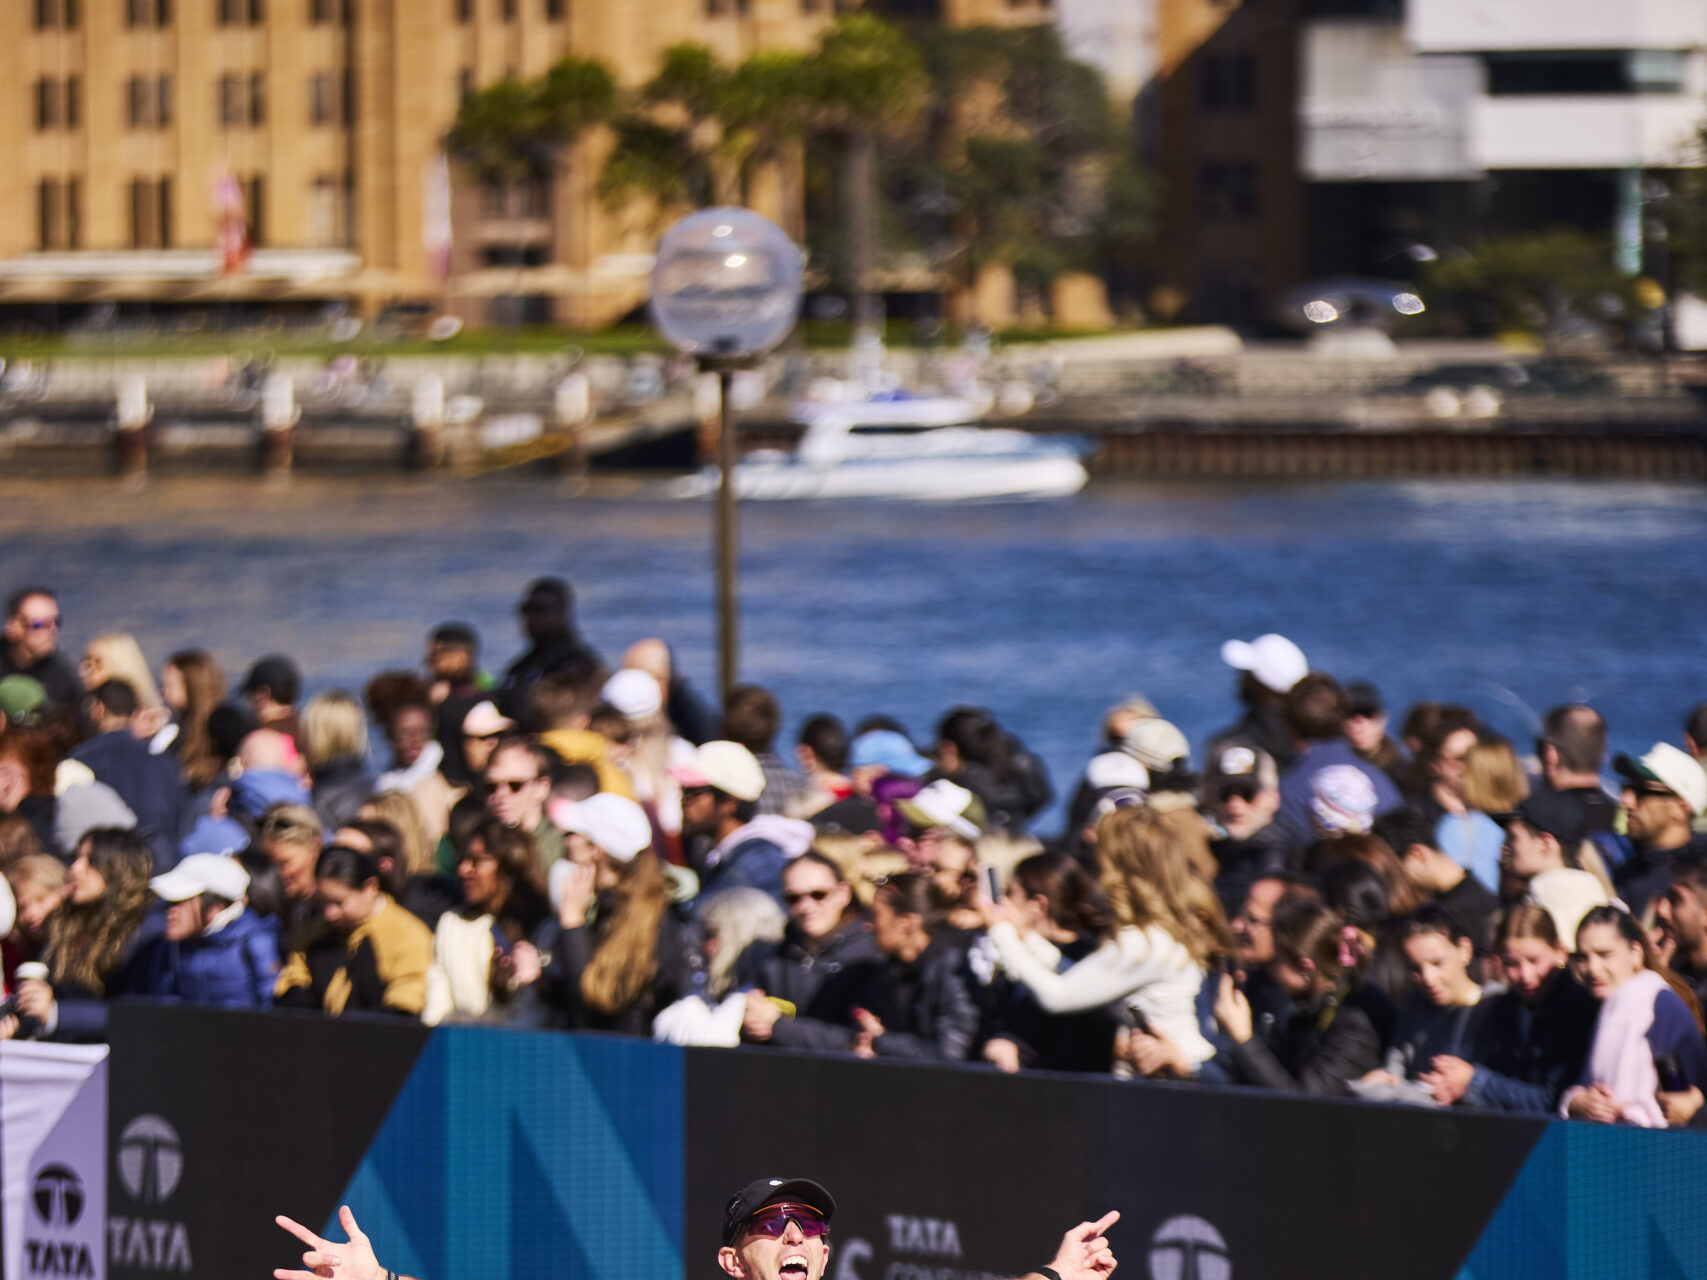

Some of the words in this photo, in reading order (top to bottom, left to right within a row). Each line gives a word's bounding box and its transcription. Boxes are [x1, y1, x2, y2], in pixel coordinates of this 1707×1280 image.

[107, 1216, 193, 1272] TATA
[886, 1214, 961, 1259] TATA
[27, 1240, 94, 1280] TATA
